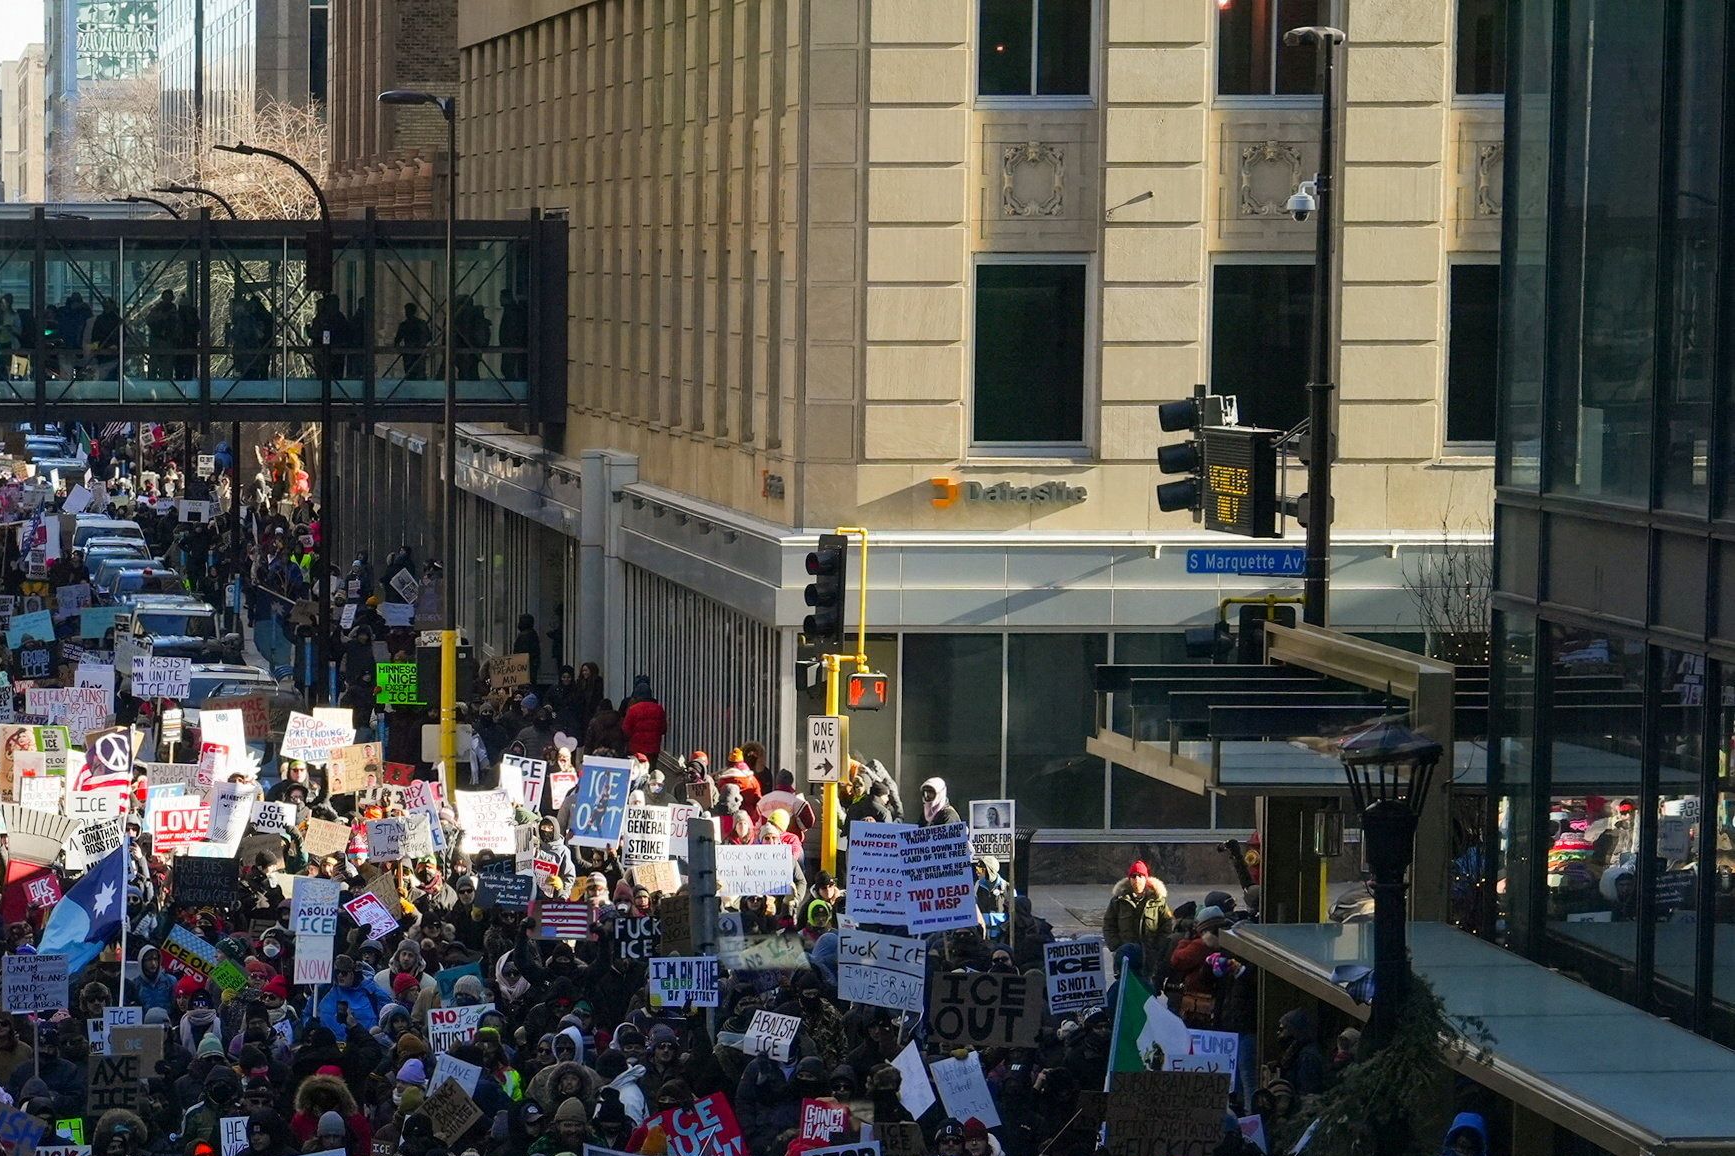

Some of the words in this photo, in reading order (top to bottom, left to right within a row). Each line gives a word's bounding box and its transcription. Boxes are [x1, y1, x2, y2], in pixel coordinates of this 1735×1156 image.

[964, 480, 1088, 503] Datasite
[1190, 554, 1198, 569] S
[1206, 554, 1275, 575] Marquette
[1283, 554, 1301, 570] Av
[150, 658, 188, 669] RESIST
[150, 670, 186, 681] UNITE
[387, 675, 417, 684] NICE
[137, 682, 160, 696] ICE
[161, 683, 189, 696] OUT!
[385, 683, 413, 691] EXCEPT
[389, 690, 417, 702] ICE
[813, 722, 834, 737] ONE
[812, 740, 834, 755] WAY
[155, 811, 209, 830] LOVE
[753, 1012, 798, 1040] ABOLISH
[756, 1034, 782, 1056] ICE
